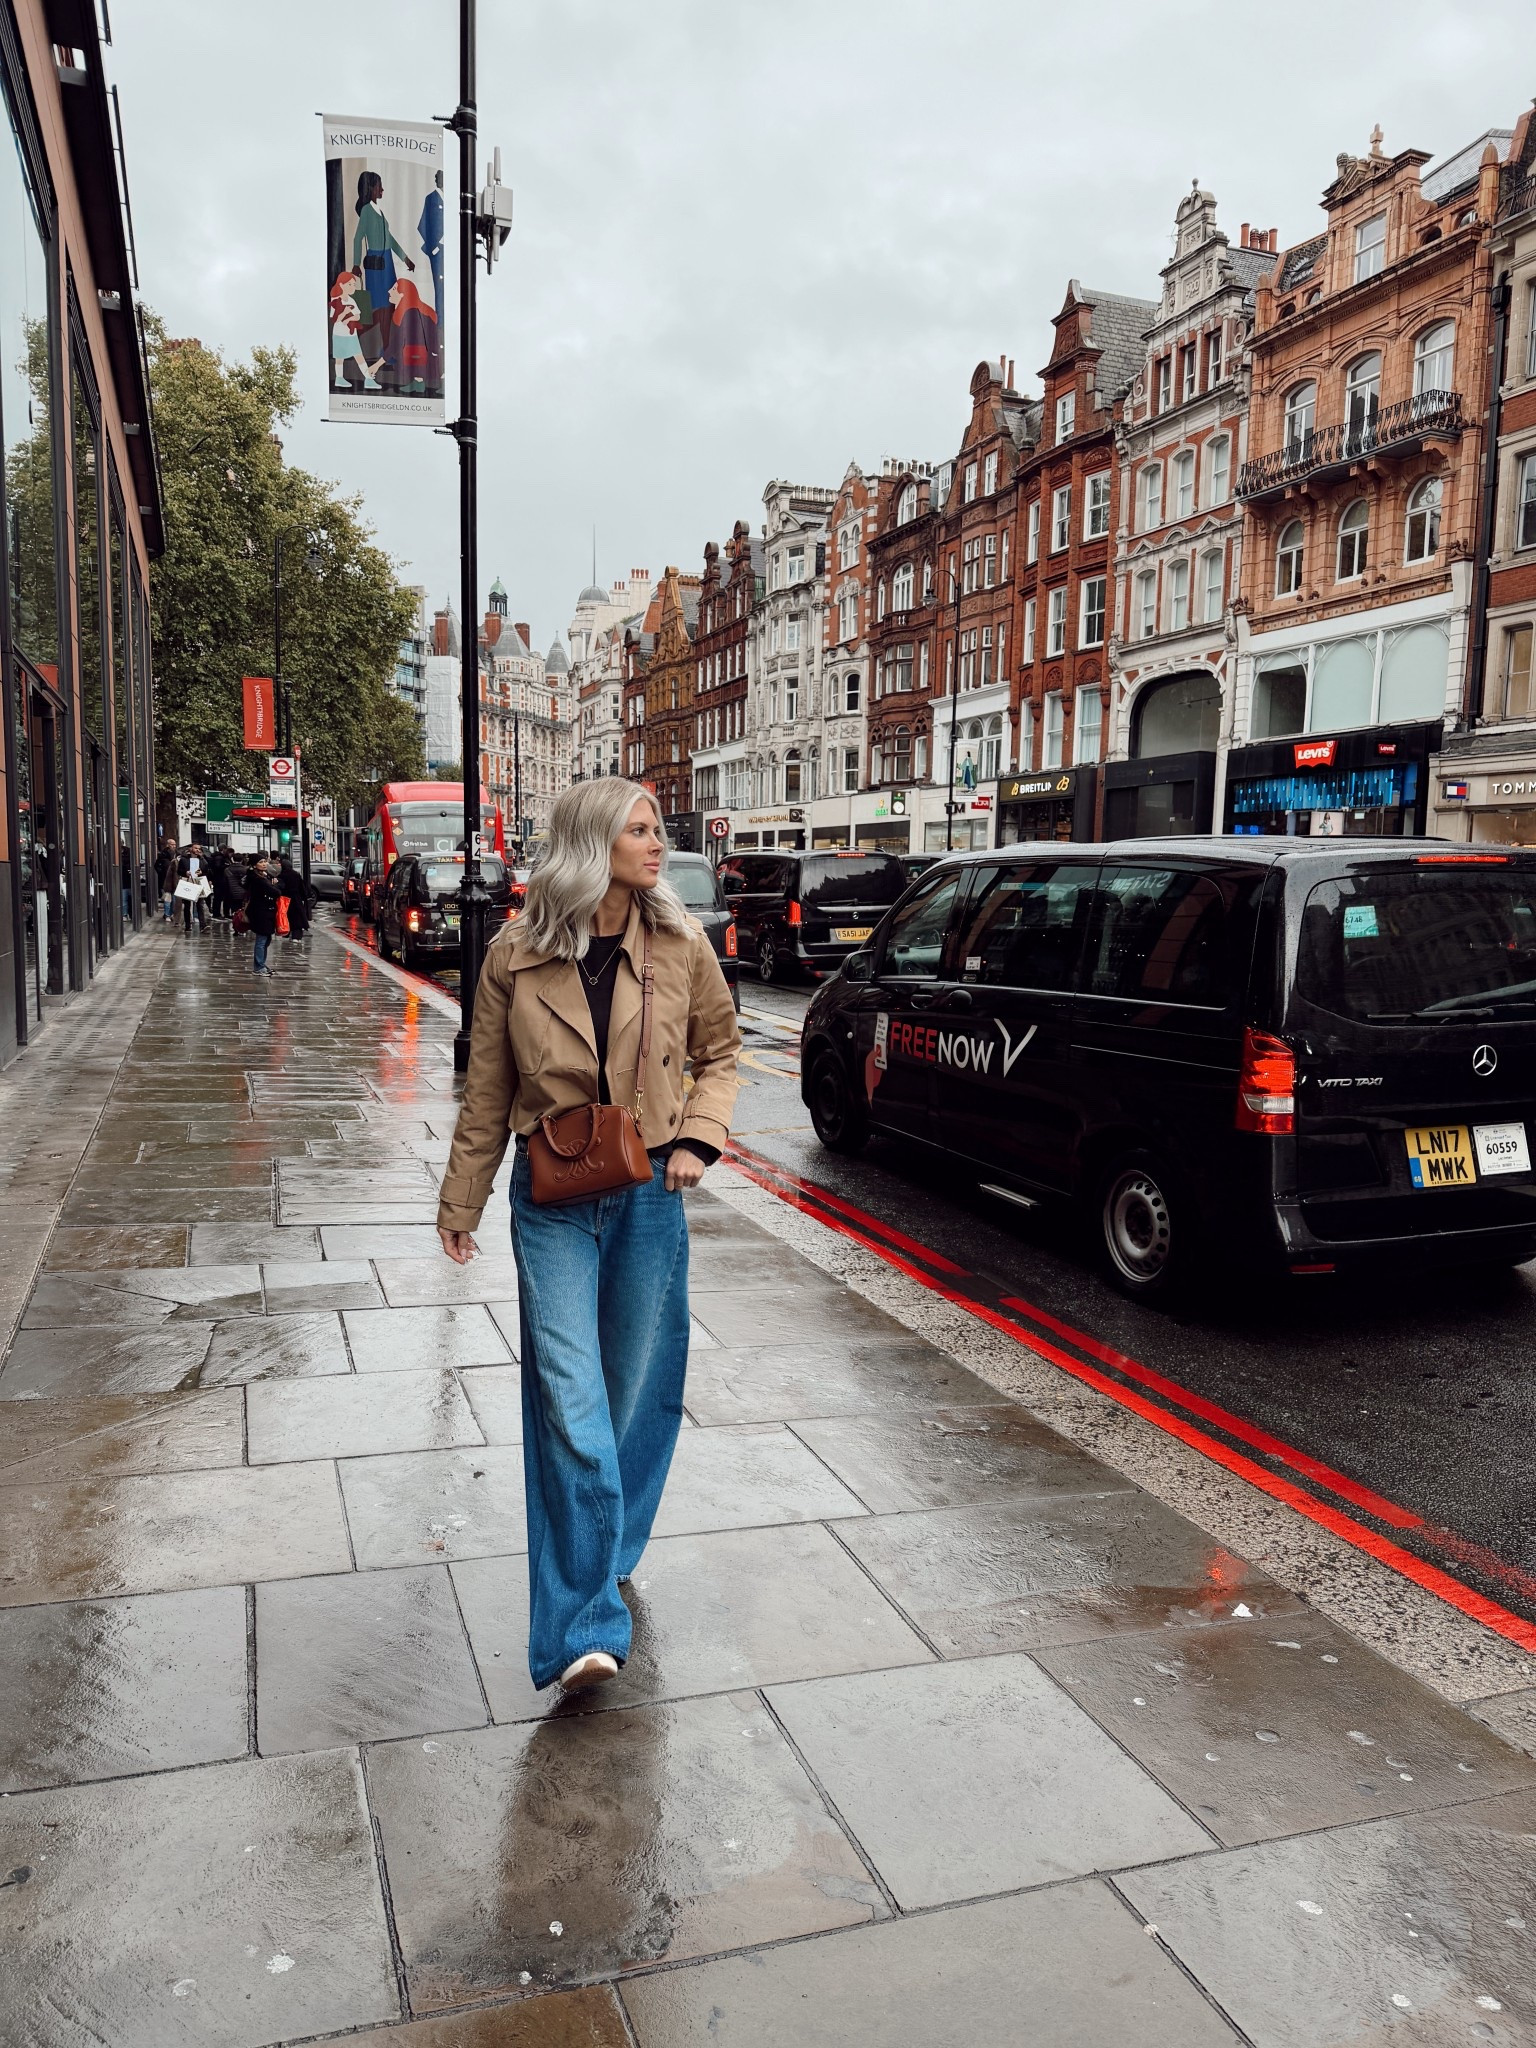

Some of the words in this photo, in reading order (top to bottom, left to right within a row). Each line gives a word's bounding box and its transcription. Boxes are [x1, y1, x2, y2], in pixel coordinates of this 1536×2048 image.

[341, 402, 433, 411] KNIGHTSBRIDGELDN.CO.UK
[1317, 1078, 1353, 1088] VITO
[1354, 1077, 1384, 1087] TAXI
[1415, 1129, 1459, 1155] LN17
[1486, 1140, 1518, 1155] 60559
[1427, 1156, 1469, 1181] MWK
